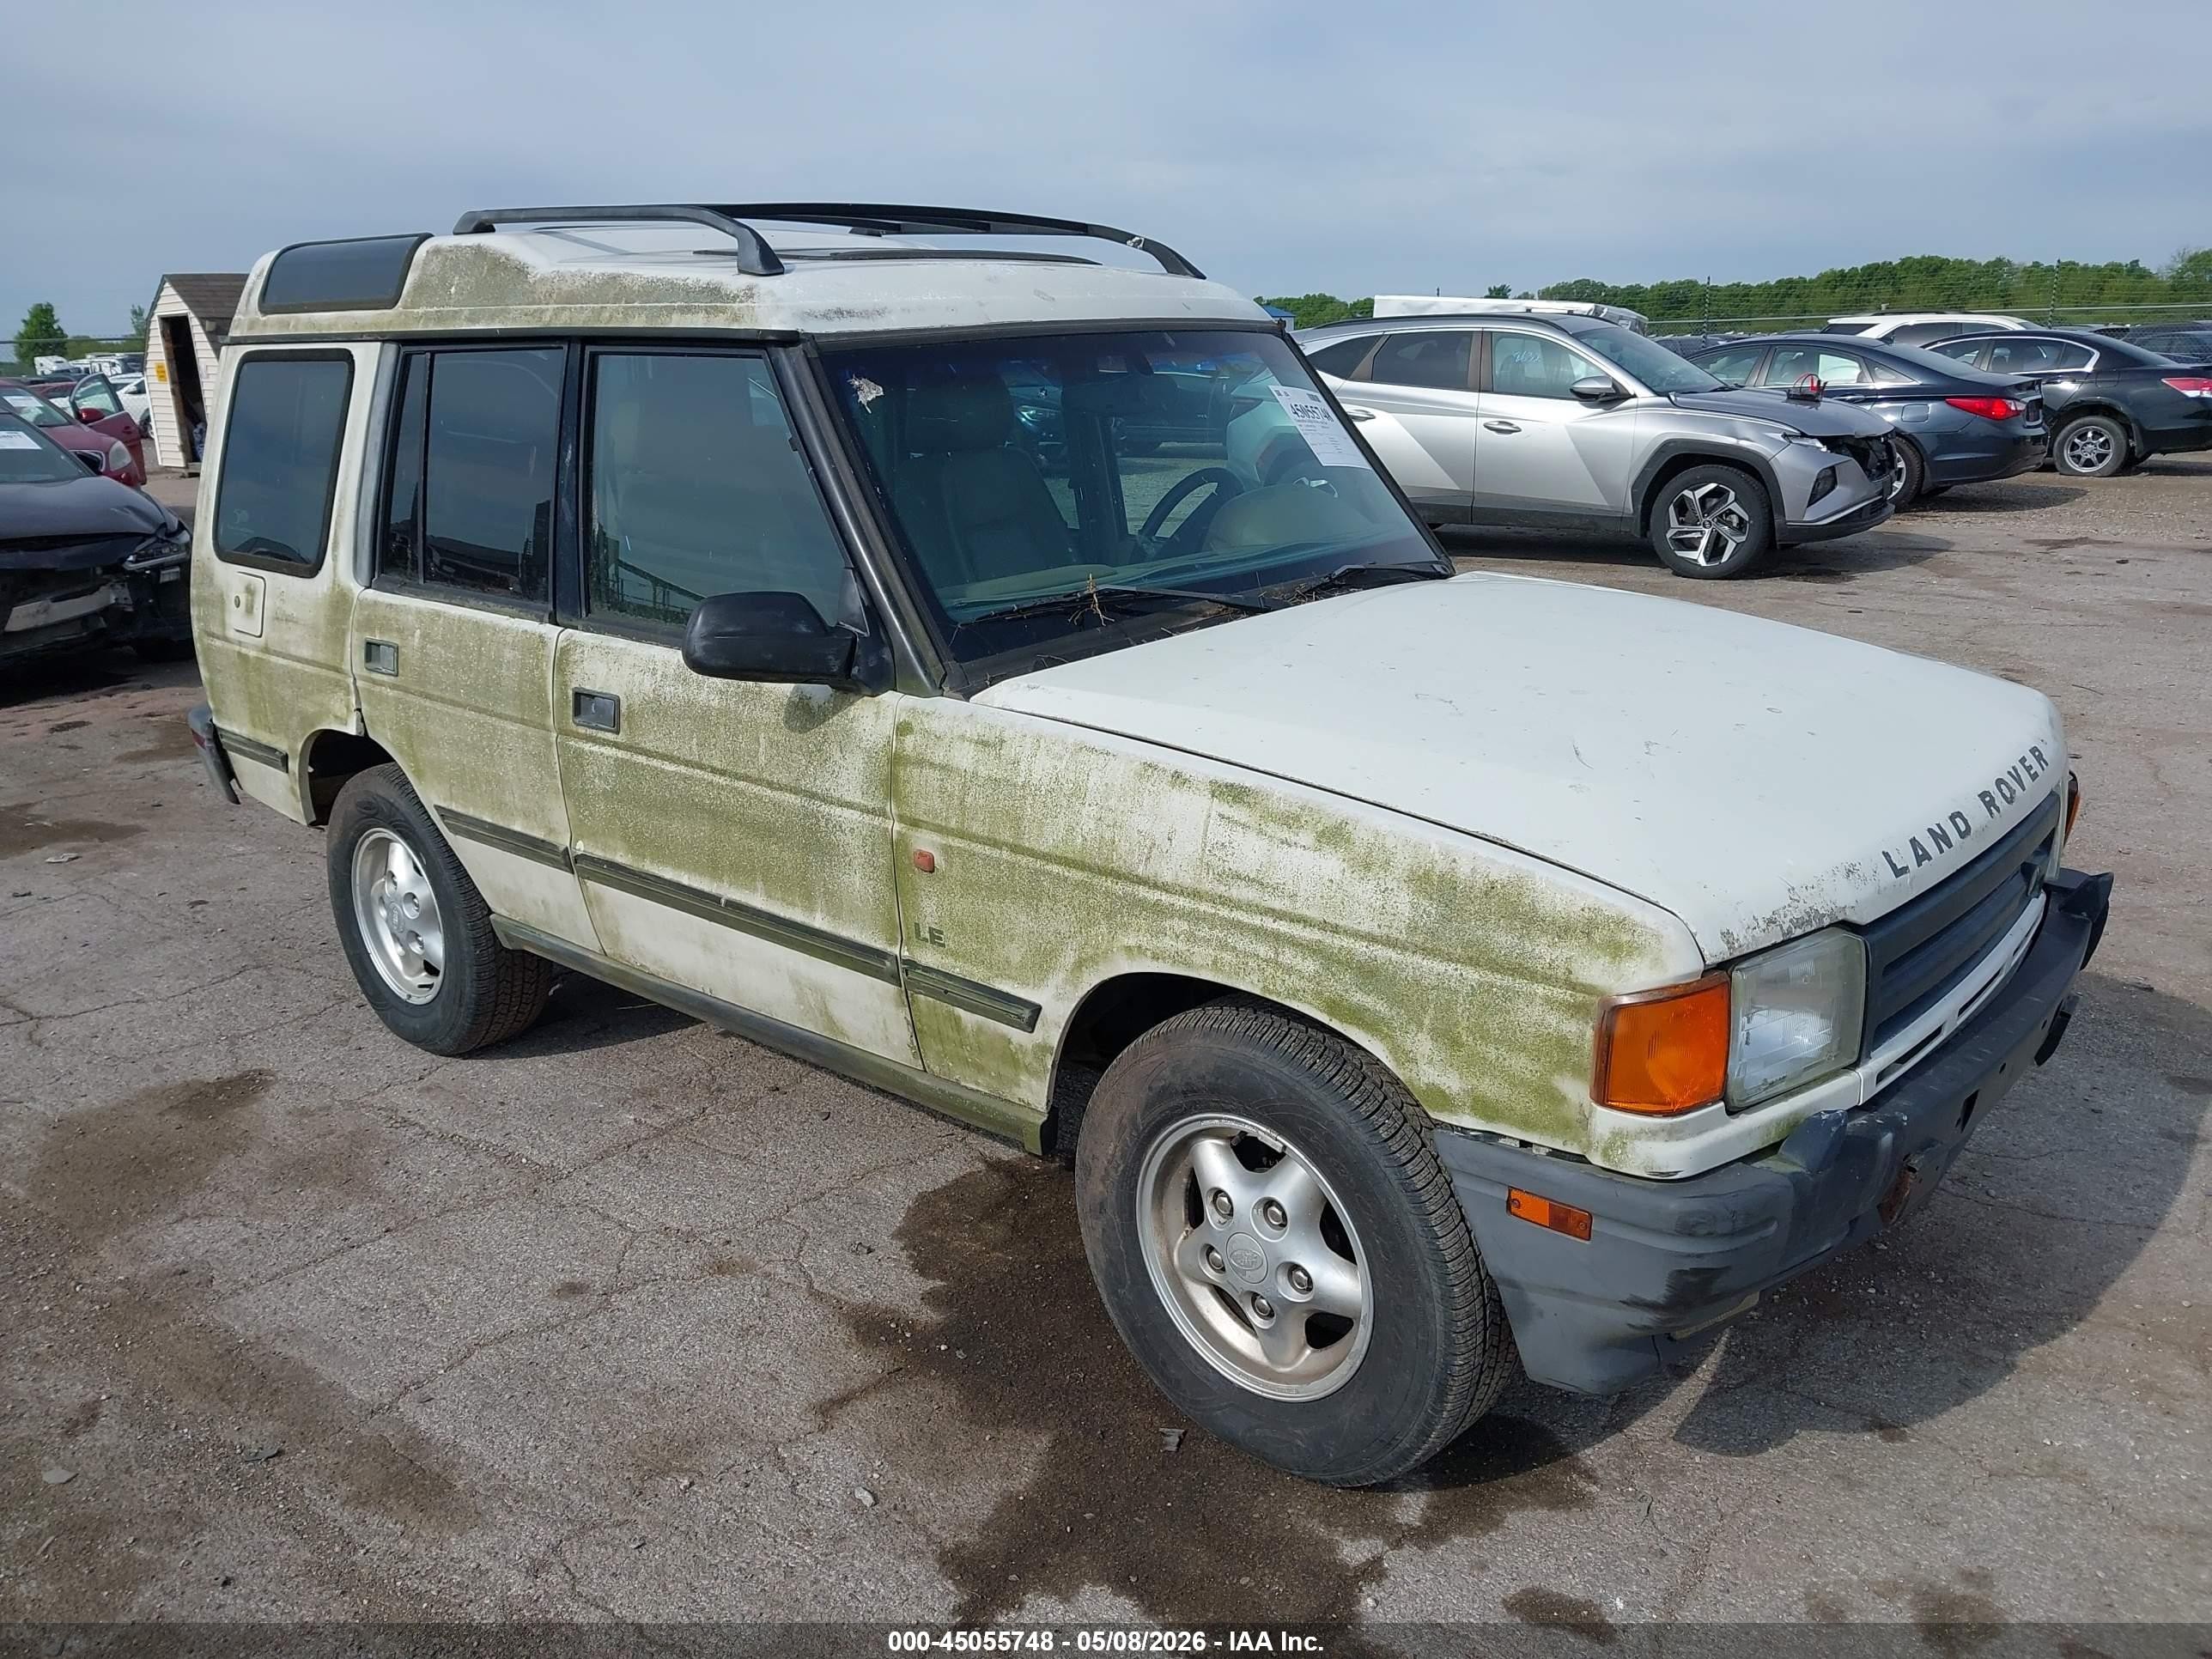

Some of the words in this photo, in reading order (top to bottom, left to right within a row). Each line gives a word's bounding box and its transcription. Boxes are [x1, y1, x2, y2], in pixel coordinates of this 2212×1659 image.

[1290, 403, 1334, 422] 45055748
[1881, 811, 1972, 878] LAND
[1978, 745, 2050, 818] ROVER
[914, 921, 946, 948] LE
